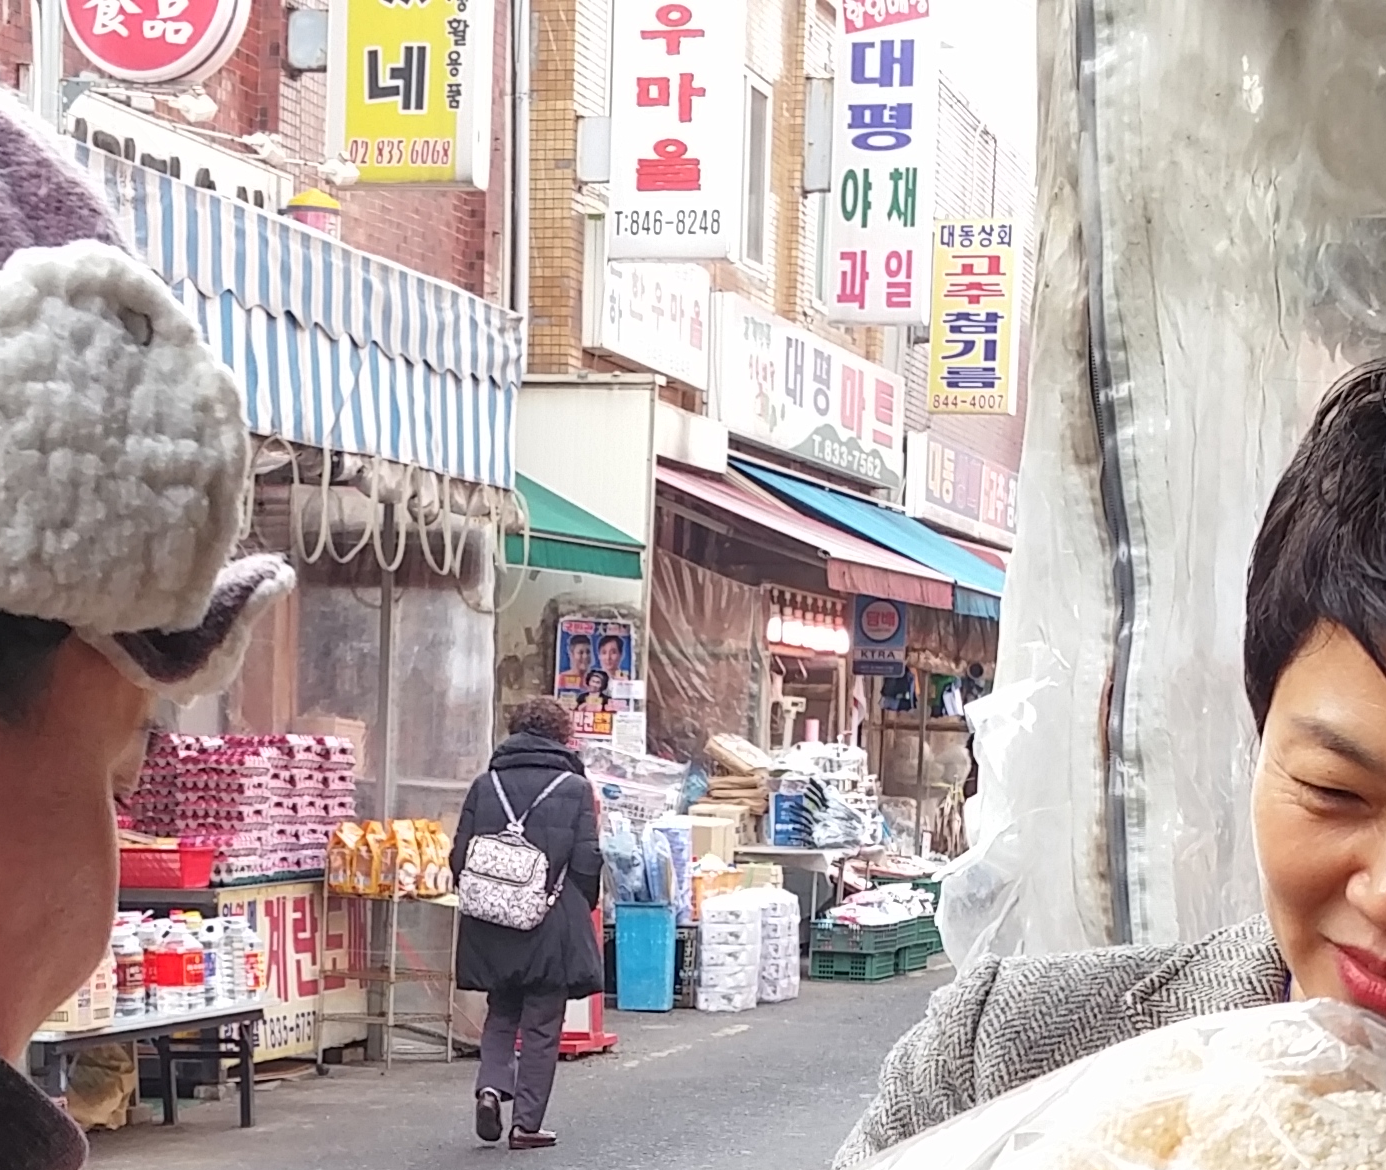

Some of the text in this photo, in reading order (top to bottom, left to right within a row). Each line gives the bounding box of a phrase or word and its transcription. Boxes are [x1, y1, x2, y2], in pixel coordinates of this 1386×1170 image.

[847, 39, 915, 151] 대평
[350, 139, 451, 165] 02 835 6068
[841, 167, 918, 228] 야채
[614, 209, 721, 236] T:846-8248
[940, 224, 1012, 248] 대동상회
[837, 250, 913, 309] 과일
[944, 255, 1007, 305] 고추
[940, 312, 1005, 389] 참기름
[932, 395, 1004, 409] 844-4007
[812, 434, 881, 479] T.833-7562
